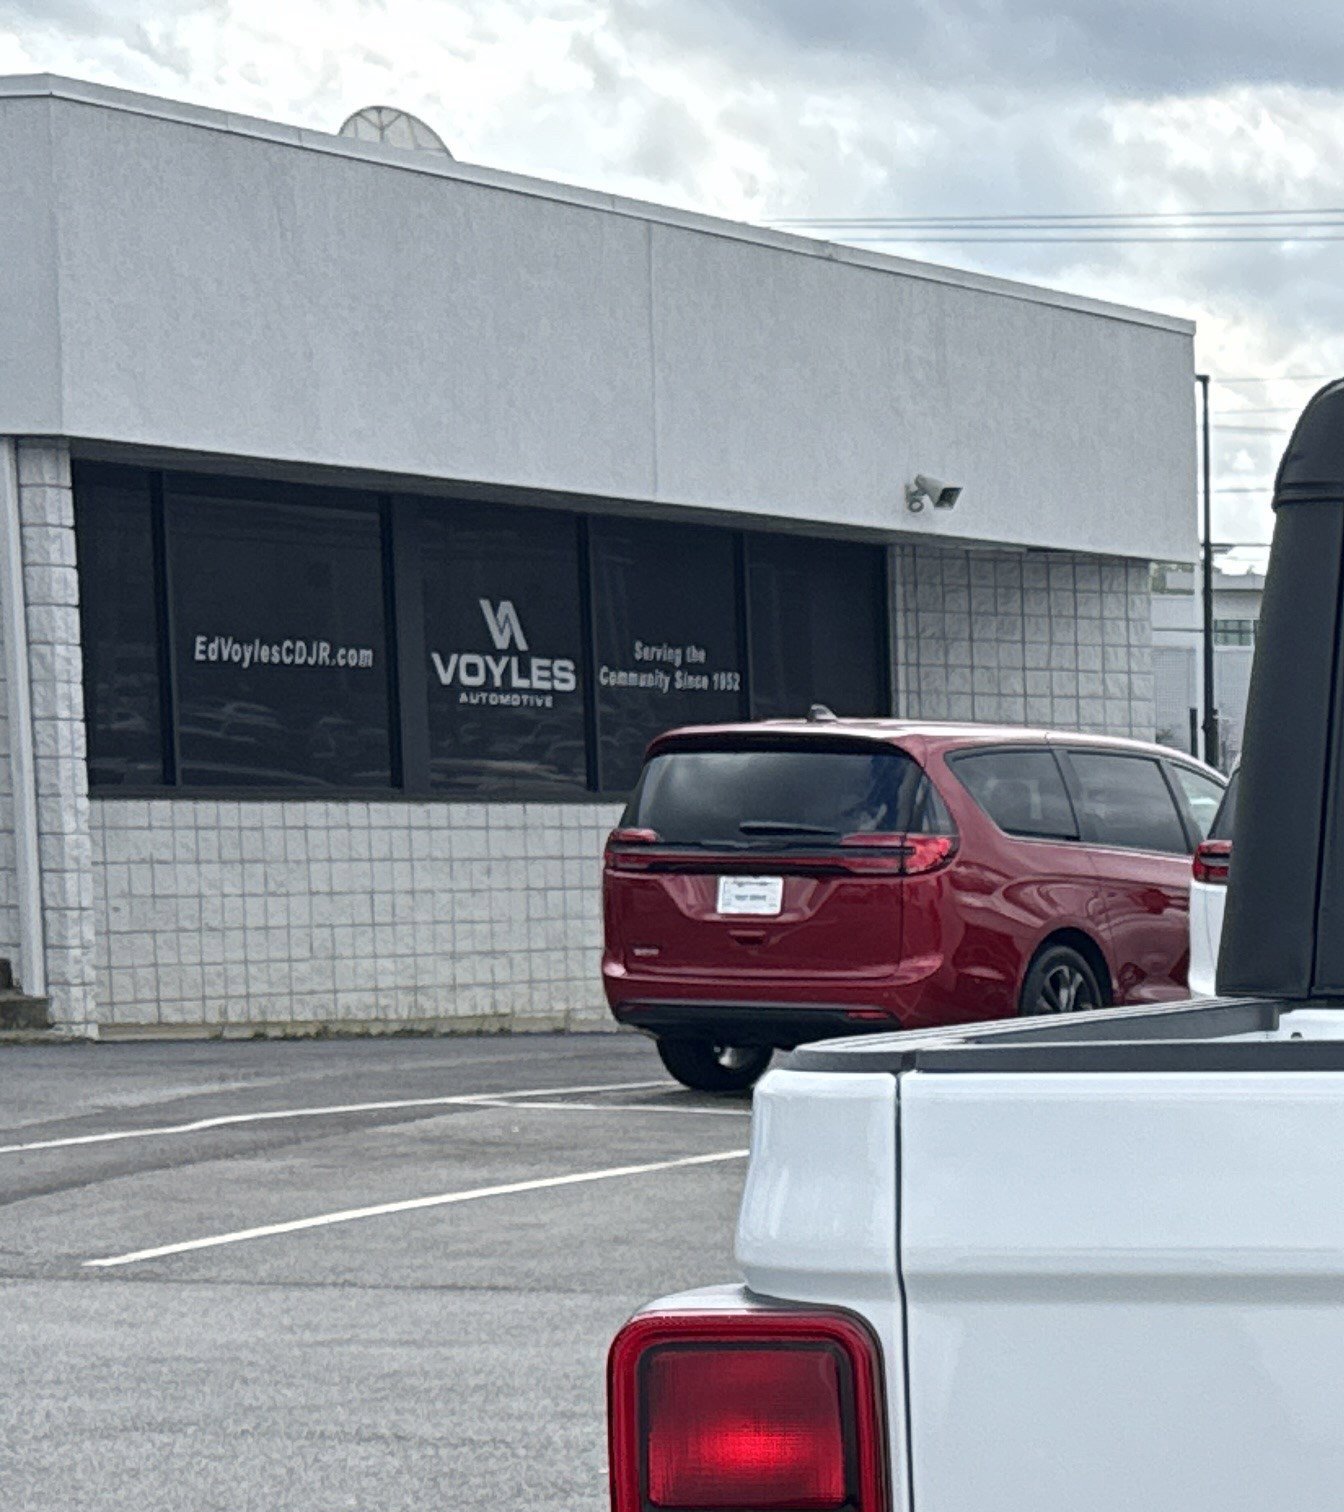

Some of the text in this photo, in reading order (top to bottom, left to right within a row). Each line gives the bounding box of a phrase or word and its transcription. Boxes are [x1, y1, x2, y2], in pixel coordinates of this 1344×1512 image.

[194, 634, 374, 669] EdVoylesCDJR.com
[634, 640, 706, 667] Serving the
[431, 652, 576, 692] VOYLES
[600, 664, 671, 694] Community
[674, 670, 709, 691] Since
[459, 692, 553, 708] AUTOMOTIVE
